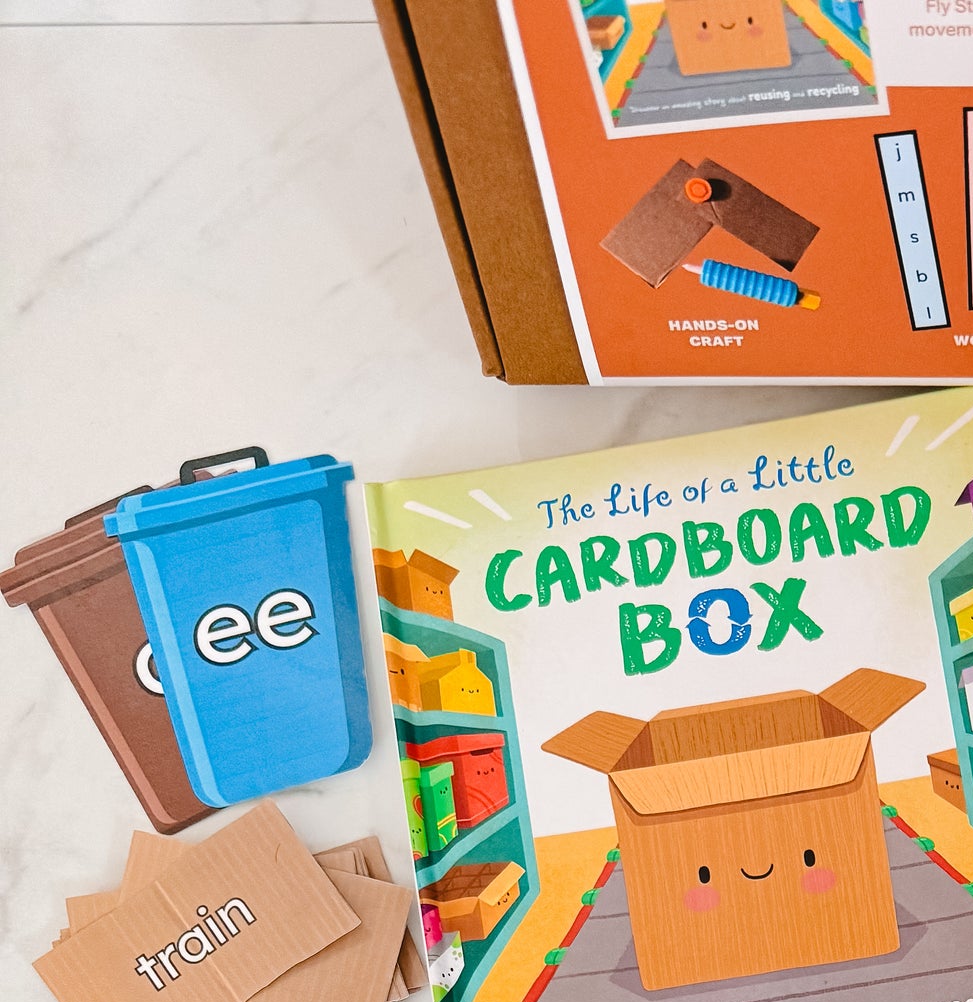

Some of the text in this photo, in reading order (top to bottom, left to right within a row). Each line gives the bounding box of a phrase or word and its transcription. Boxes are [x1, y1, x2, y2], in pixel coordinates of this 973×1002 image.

[926, 0, 950, 16] Fly
[748, 88, 791, 102] reusing
[807, 83, 859, 98] recycling
[895, 142, 902, 162] j
[897, 190, 916, 203] m
[910, 232, 920, 244] s
[915, 269, 928, 283] b
[926, 306, 932, 320] l
[668, 319, 760, 331] HANDS-ON
[689, 335, 744, 347] CRAFT
[537, 445, 855, 529] The Life of a Little
[485, 485, 932, 612] CARDBOARD
[193, 588, 320, 667] ee
[619, 577, 824, 676] BOX
[135, 897, 257, 992] train
